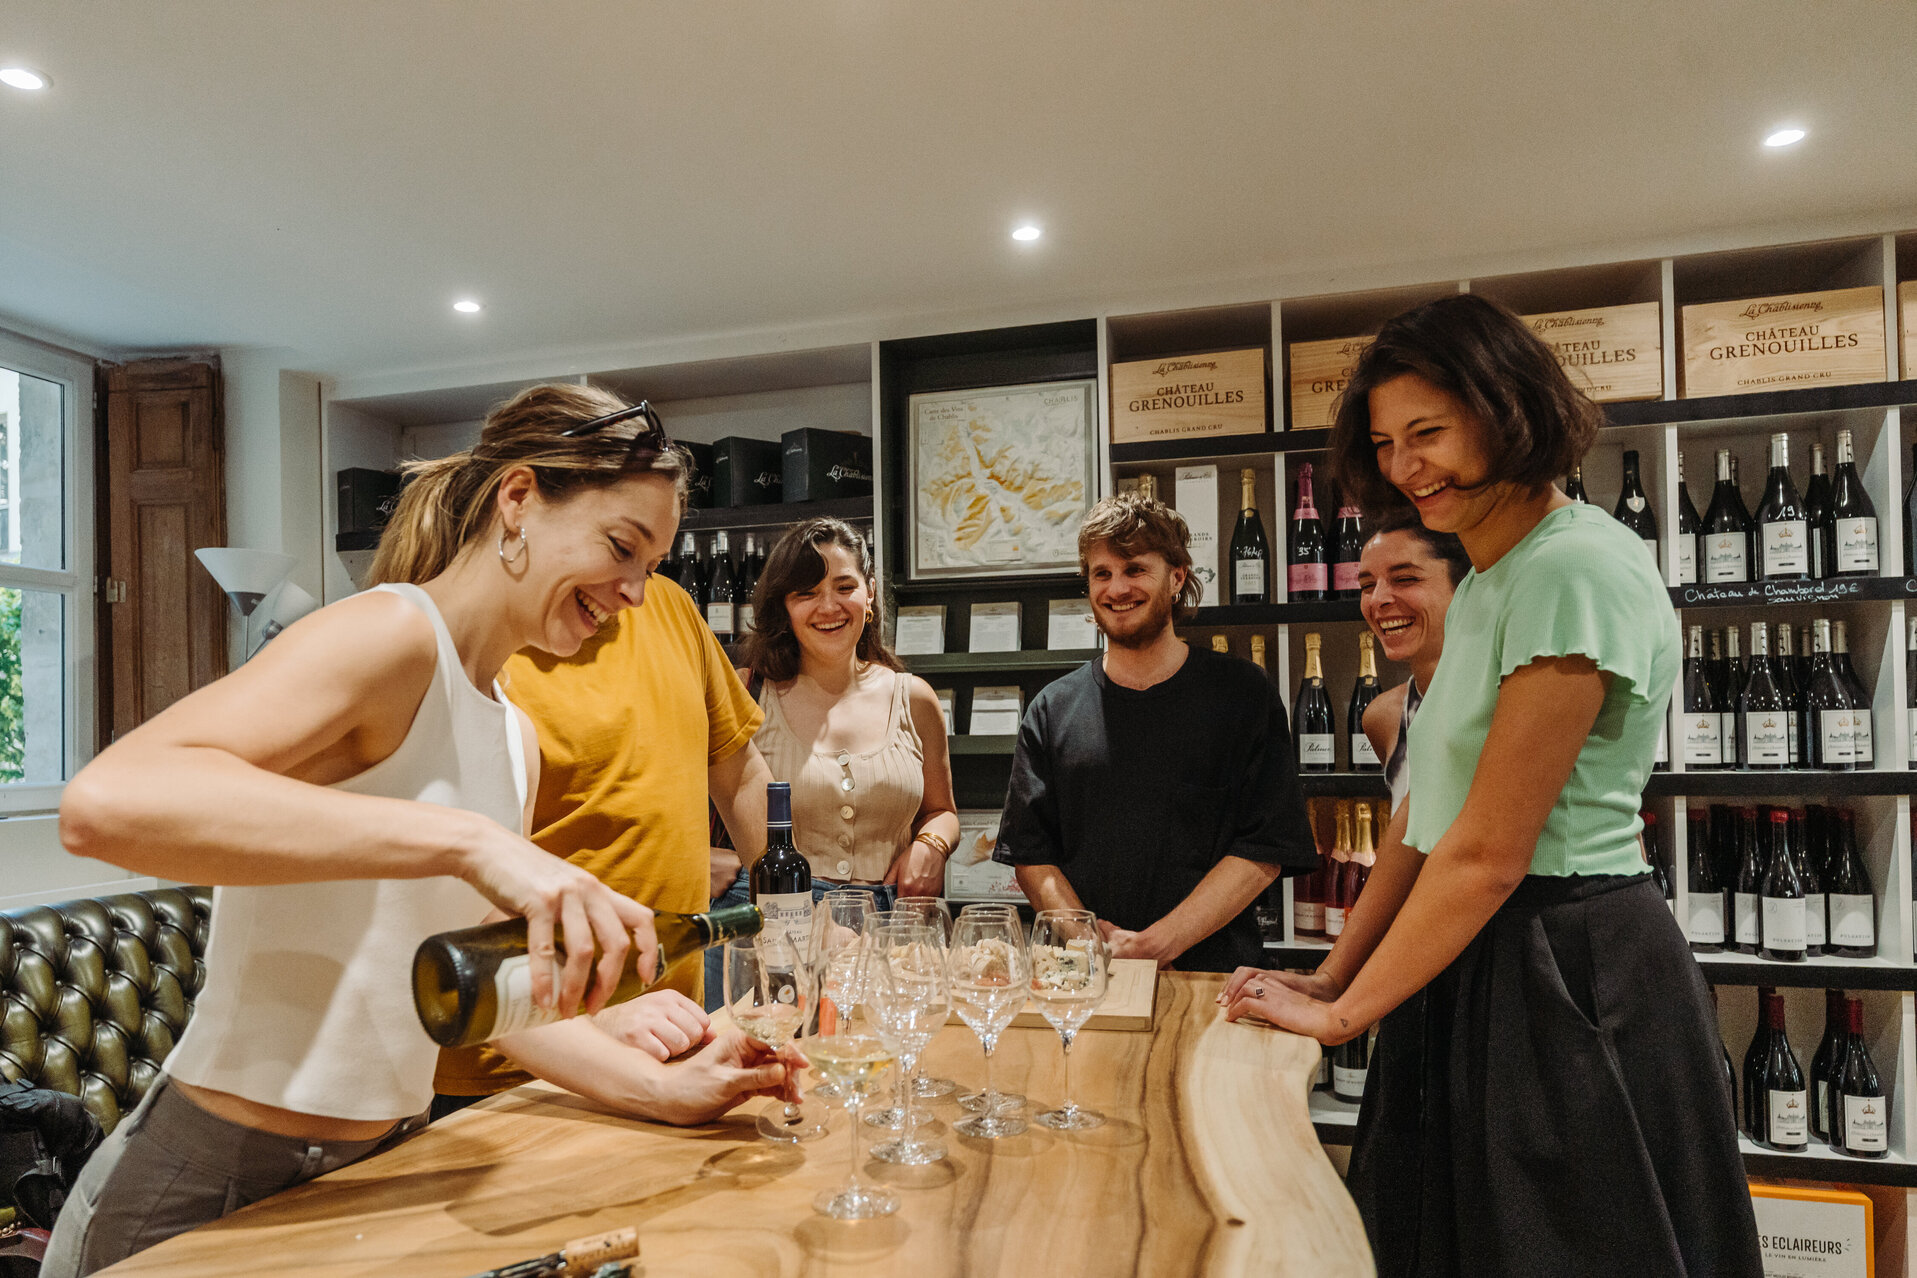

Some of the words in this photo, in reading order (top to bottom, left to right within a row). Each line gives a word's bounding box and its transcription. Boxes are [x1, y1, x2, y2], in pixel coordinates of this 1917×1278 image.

[1739, 303, 1760, 320] La
[1745, 325, 1820, 342] CHÂTEAU
[1709, 333, 1859, 360] GRENOUILLES
[1558, 348, 1637, 367] OUILLES
[1737, 377, 1777, 386] CHABLIS
[1778, 374, 1811, 382] GRAND
[1812, 371, 1832, 379] CRU
[1156, 382, 1215, 397] CHÂTEAU
[1129, 390, 1244, 412] GRENOUILLES
[1149, 427, 1180, 435] CHABLIS
[1181, 425, 1207, 433] GRAND
[1777, 505, 1795, 519] 19
[1764, 581, 1825, 597] Chambord
[1772, 1235, 1843, 1255] ECLAIREURS
